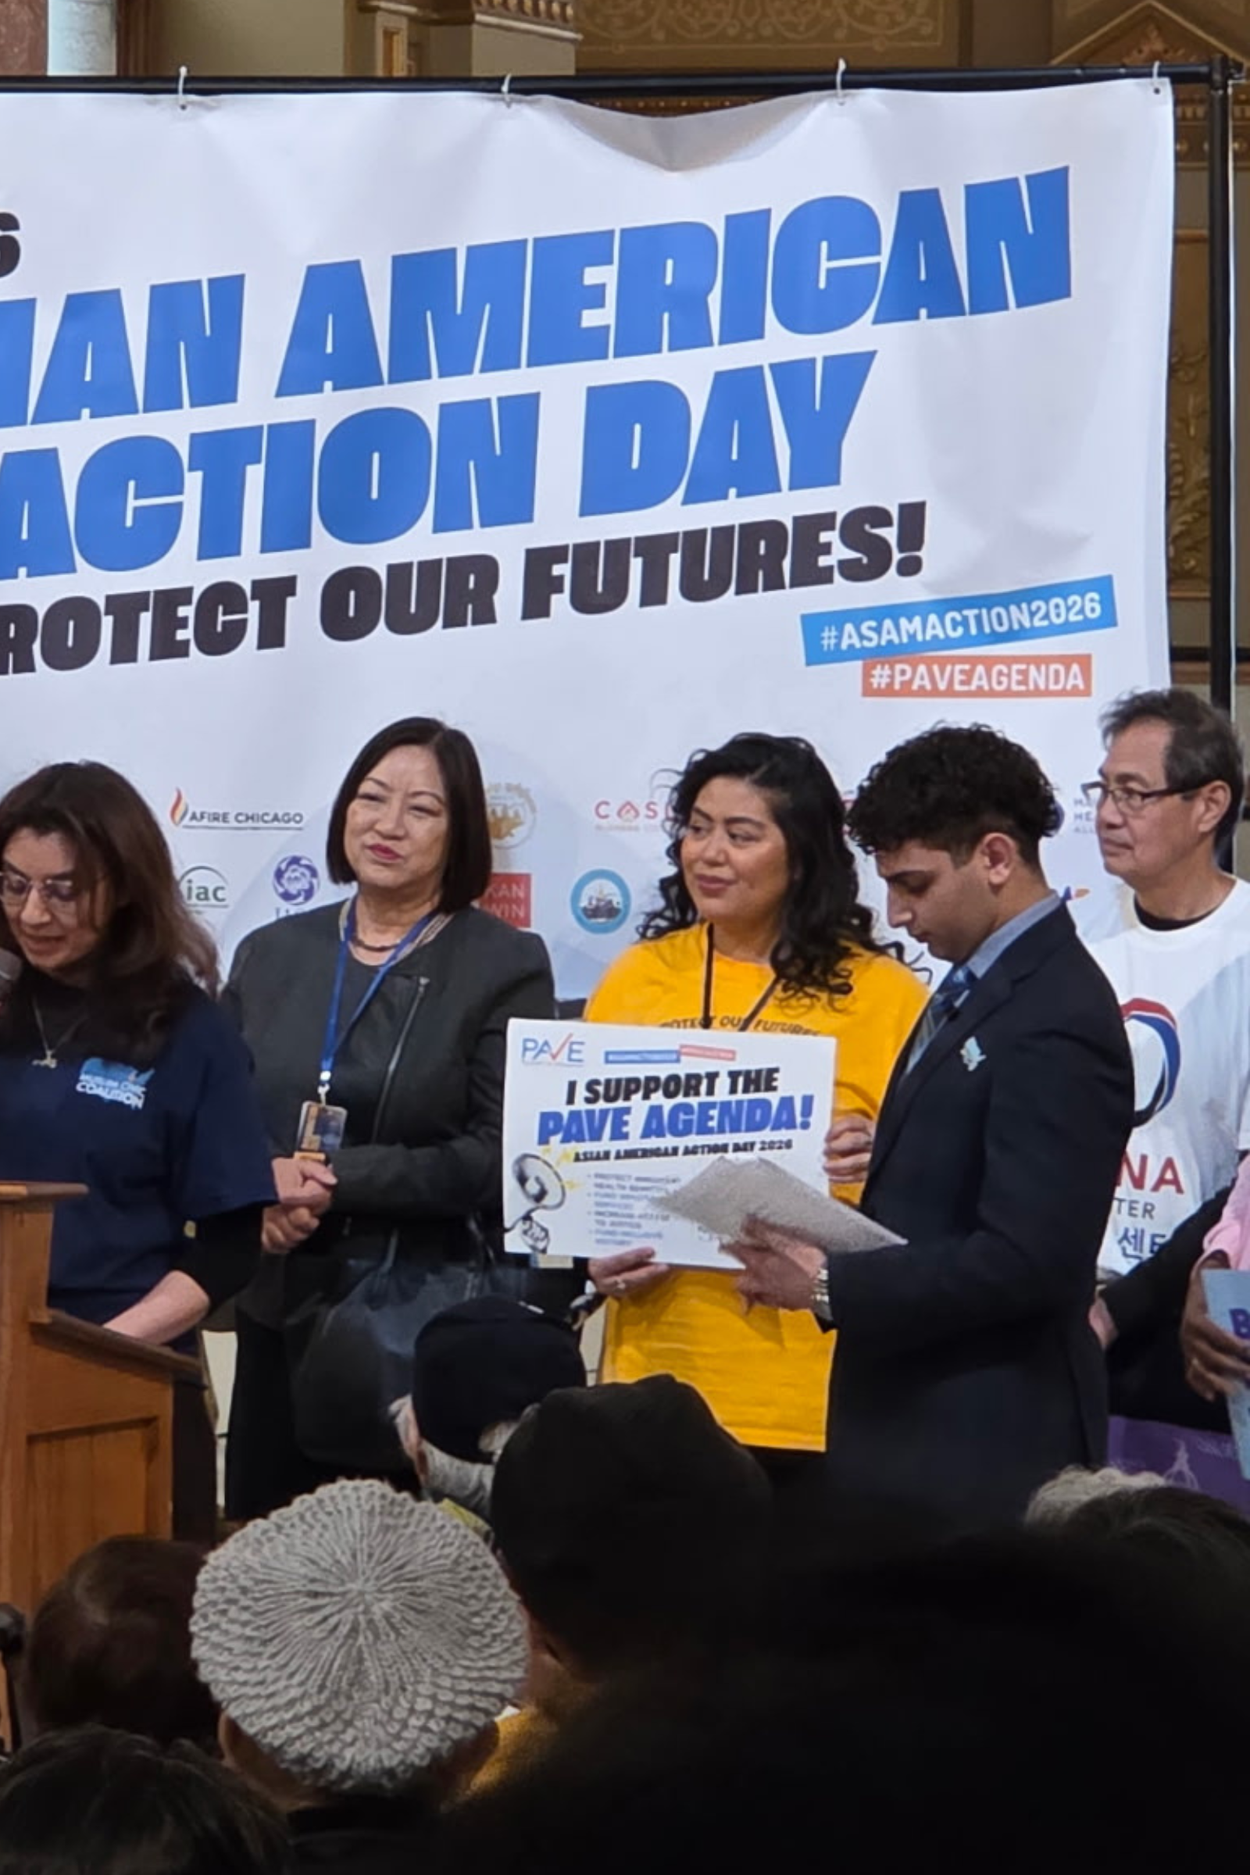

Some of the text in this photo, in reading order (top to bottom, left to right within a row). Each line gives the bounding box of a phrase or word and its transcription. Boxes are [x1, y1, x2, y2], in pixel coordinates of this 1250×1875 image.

[274, 165, 1072, 398] AMERICAN
[578, 349, 878, 518] DAY
[319, 554, 499, 642] OUR
[520, 501, 927, 621] FUTURES!
[819, 591, 1102, 652] #ASAMACTION2026
[869, 664, 1085, 692] #PAVEAGENDA
[189, 811, 304, 825] AFIRE CHICAGO
[566, 1067, 780, 1105] I SUPPORT THE
[538, 1095, 814, 1145] PAVE AGENDA!
[573, 1151, 611, 1163] ASIAN
[613, 1146, 680, 1160] AMERICAN
[758, 1139, 793, 1151] 2026
[1117, 1153, 1185, 1195] NA
[1114, 1198, 1156, 1220] TER
